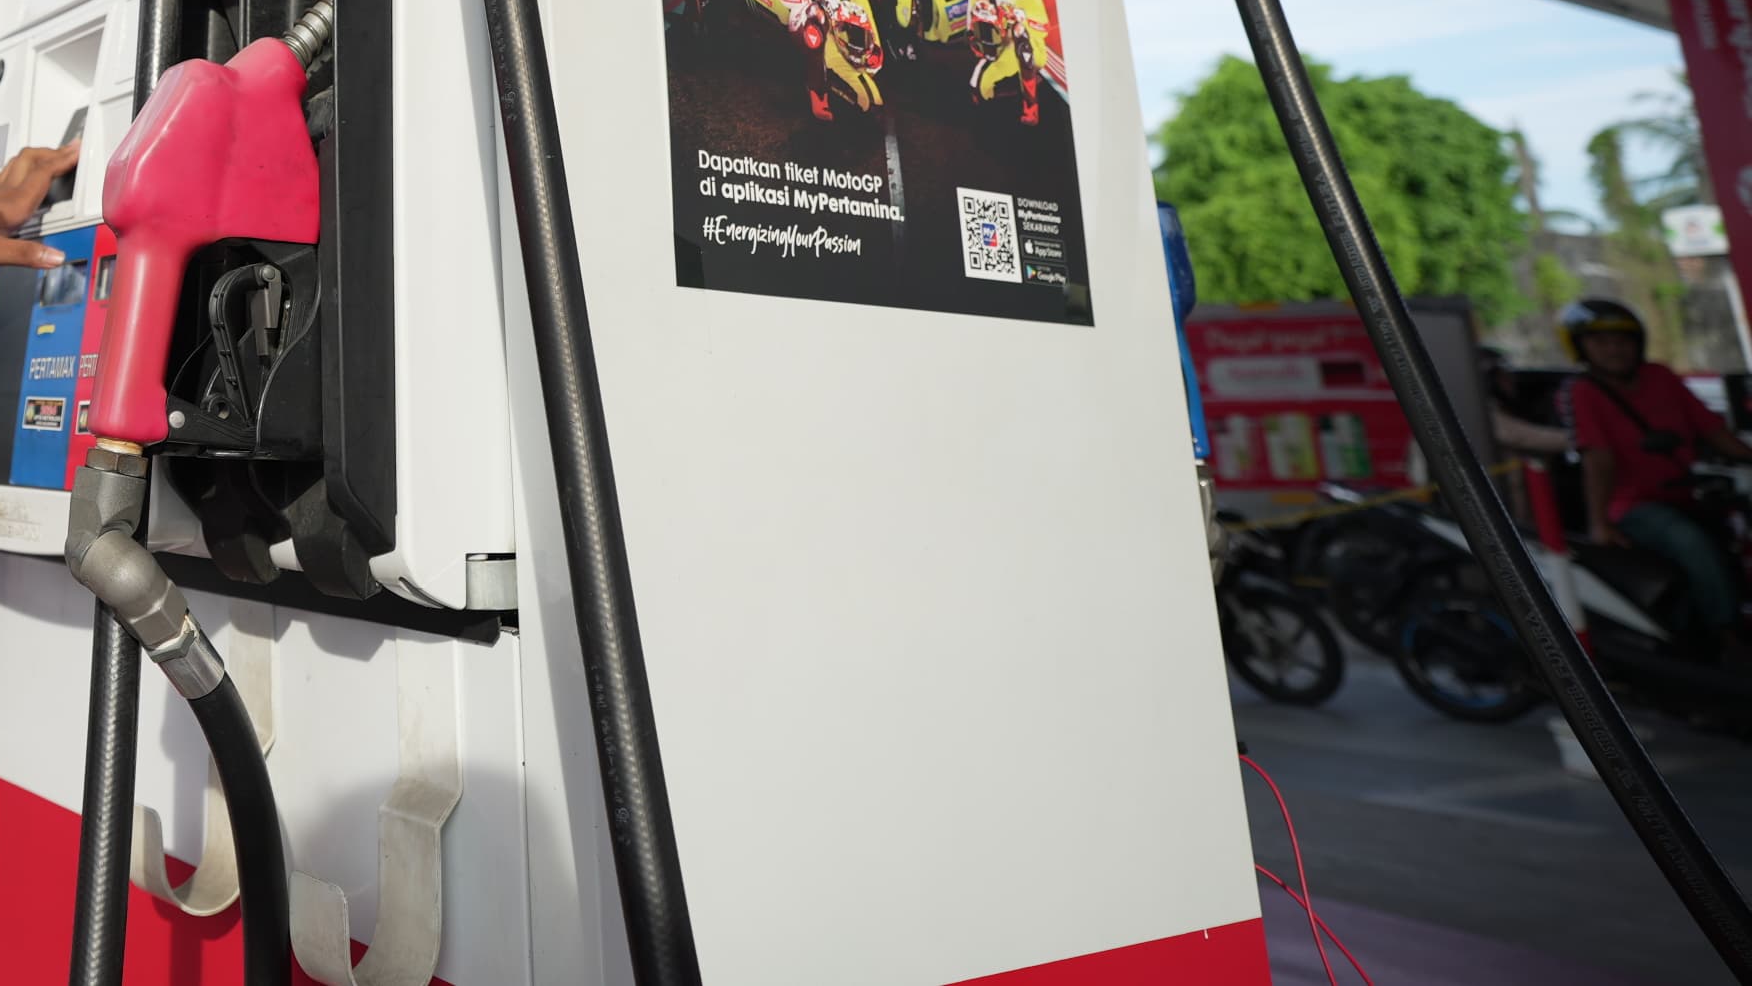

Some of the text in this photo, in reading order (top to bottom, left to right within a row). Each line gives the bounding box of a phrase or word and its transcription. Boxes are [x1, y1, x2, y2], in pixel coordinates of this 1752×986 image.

[698, 149, 884, 194] Dapatkan tiket MotoGP
[699, 176, 906, 223] di aplikasi MyPertamina.
[1016, 197, 1059, 212] DOWNLOAD
[702, 214, 862, 259] #EnergizingYourPassion
[1022, 221, 1060, 235] SEKARANG
[28, 356, 77, 381] PERTAMAX
